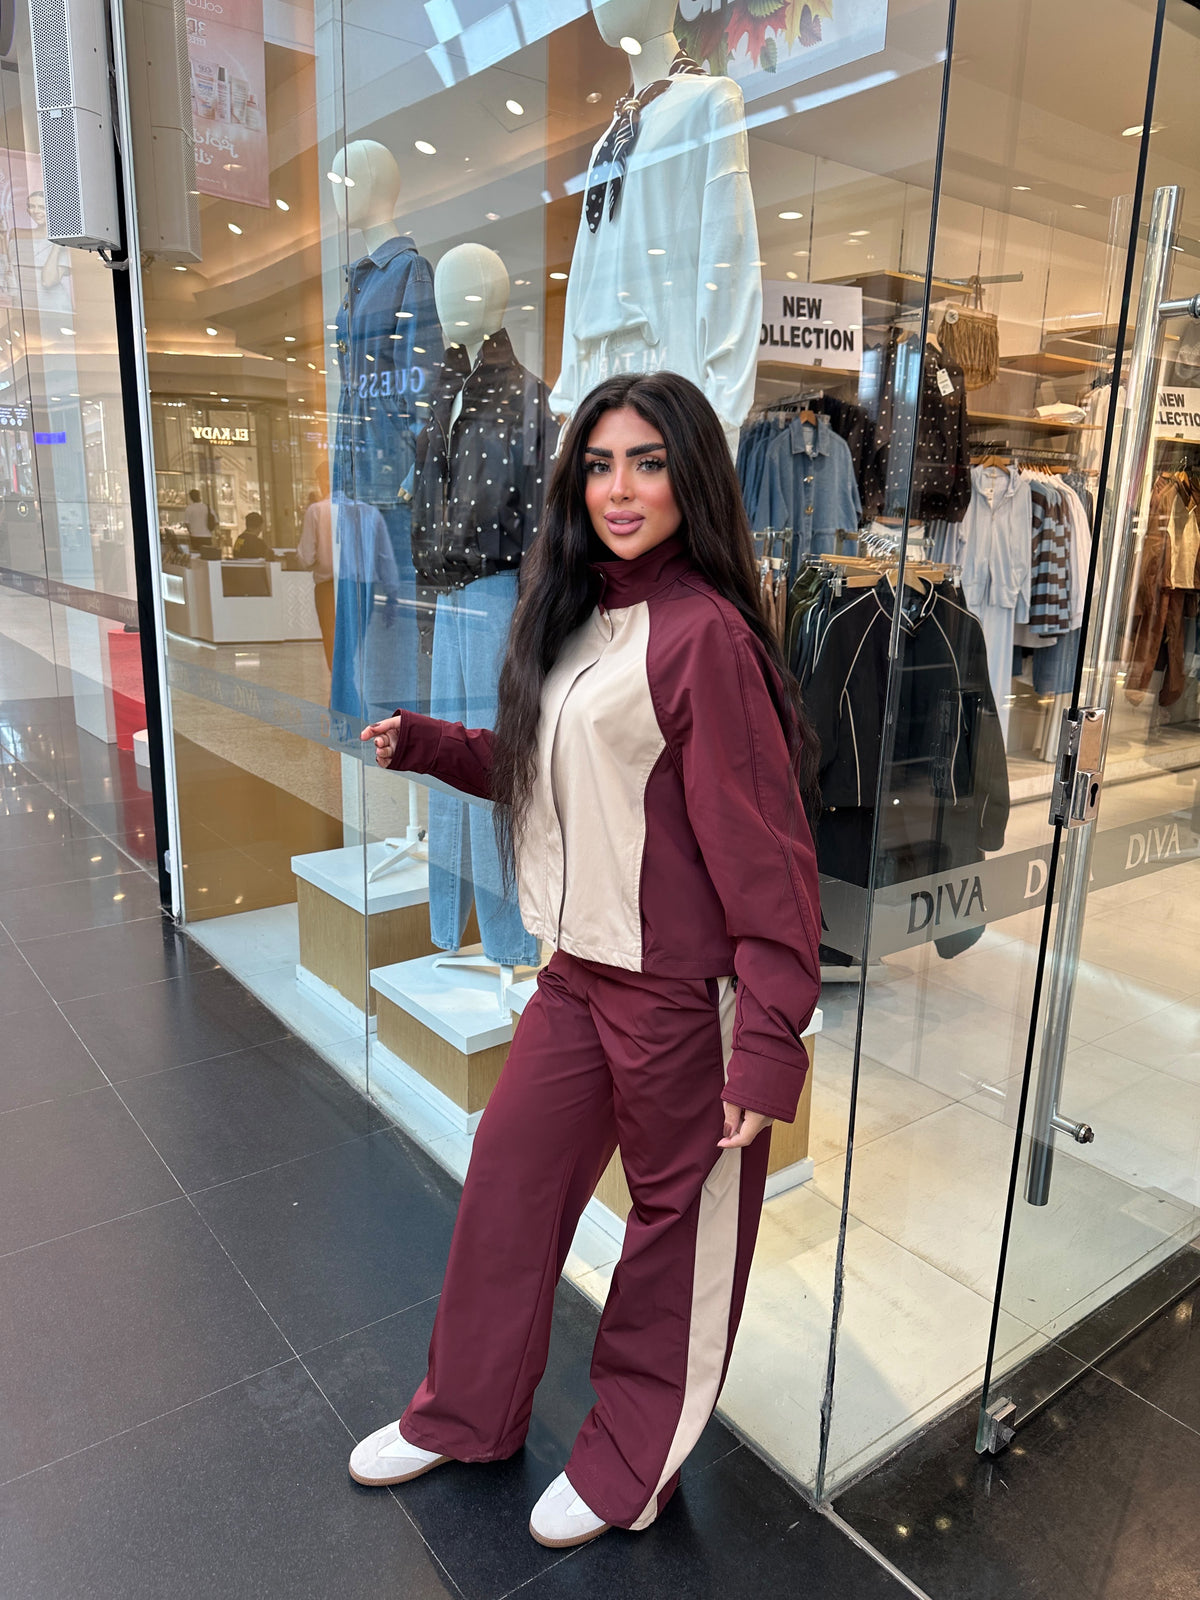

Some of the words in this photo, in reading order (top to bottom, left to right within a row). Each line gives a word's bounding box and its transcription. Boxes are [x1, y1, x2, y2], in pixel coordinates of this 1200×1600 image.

[783, 296, 822, 319] NEW
[760, 324, 854, 351] OLLECTION
[1158, 393, 1185, 407] NEW
[1124, 823, 1181, 870] DIVA
[907, 876, 987, 934] DIVA
